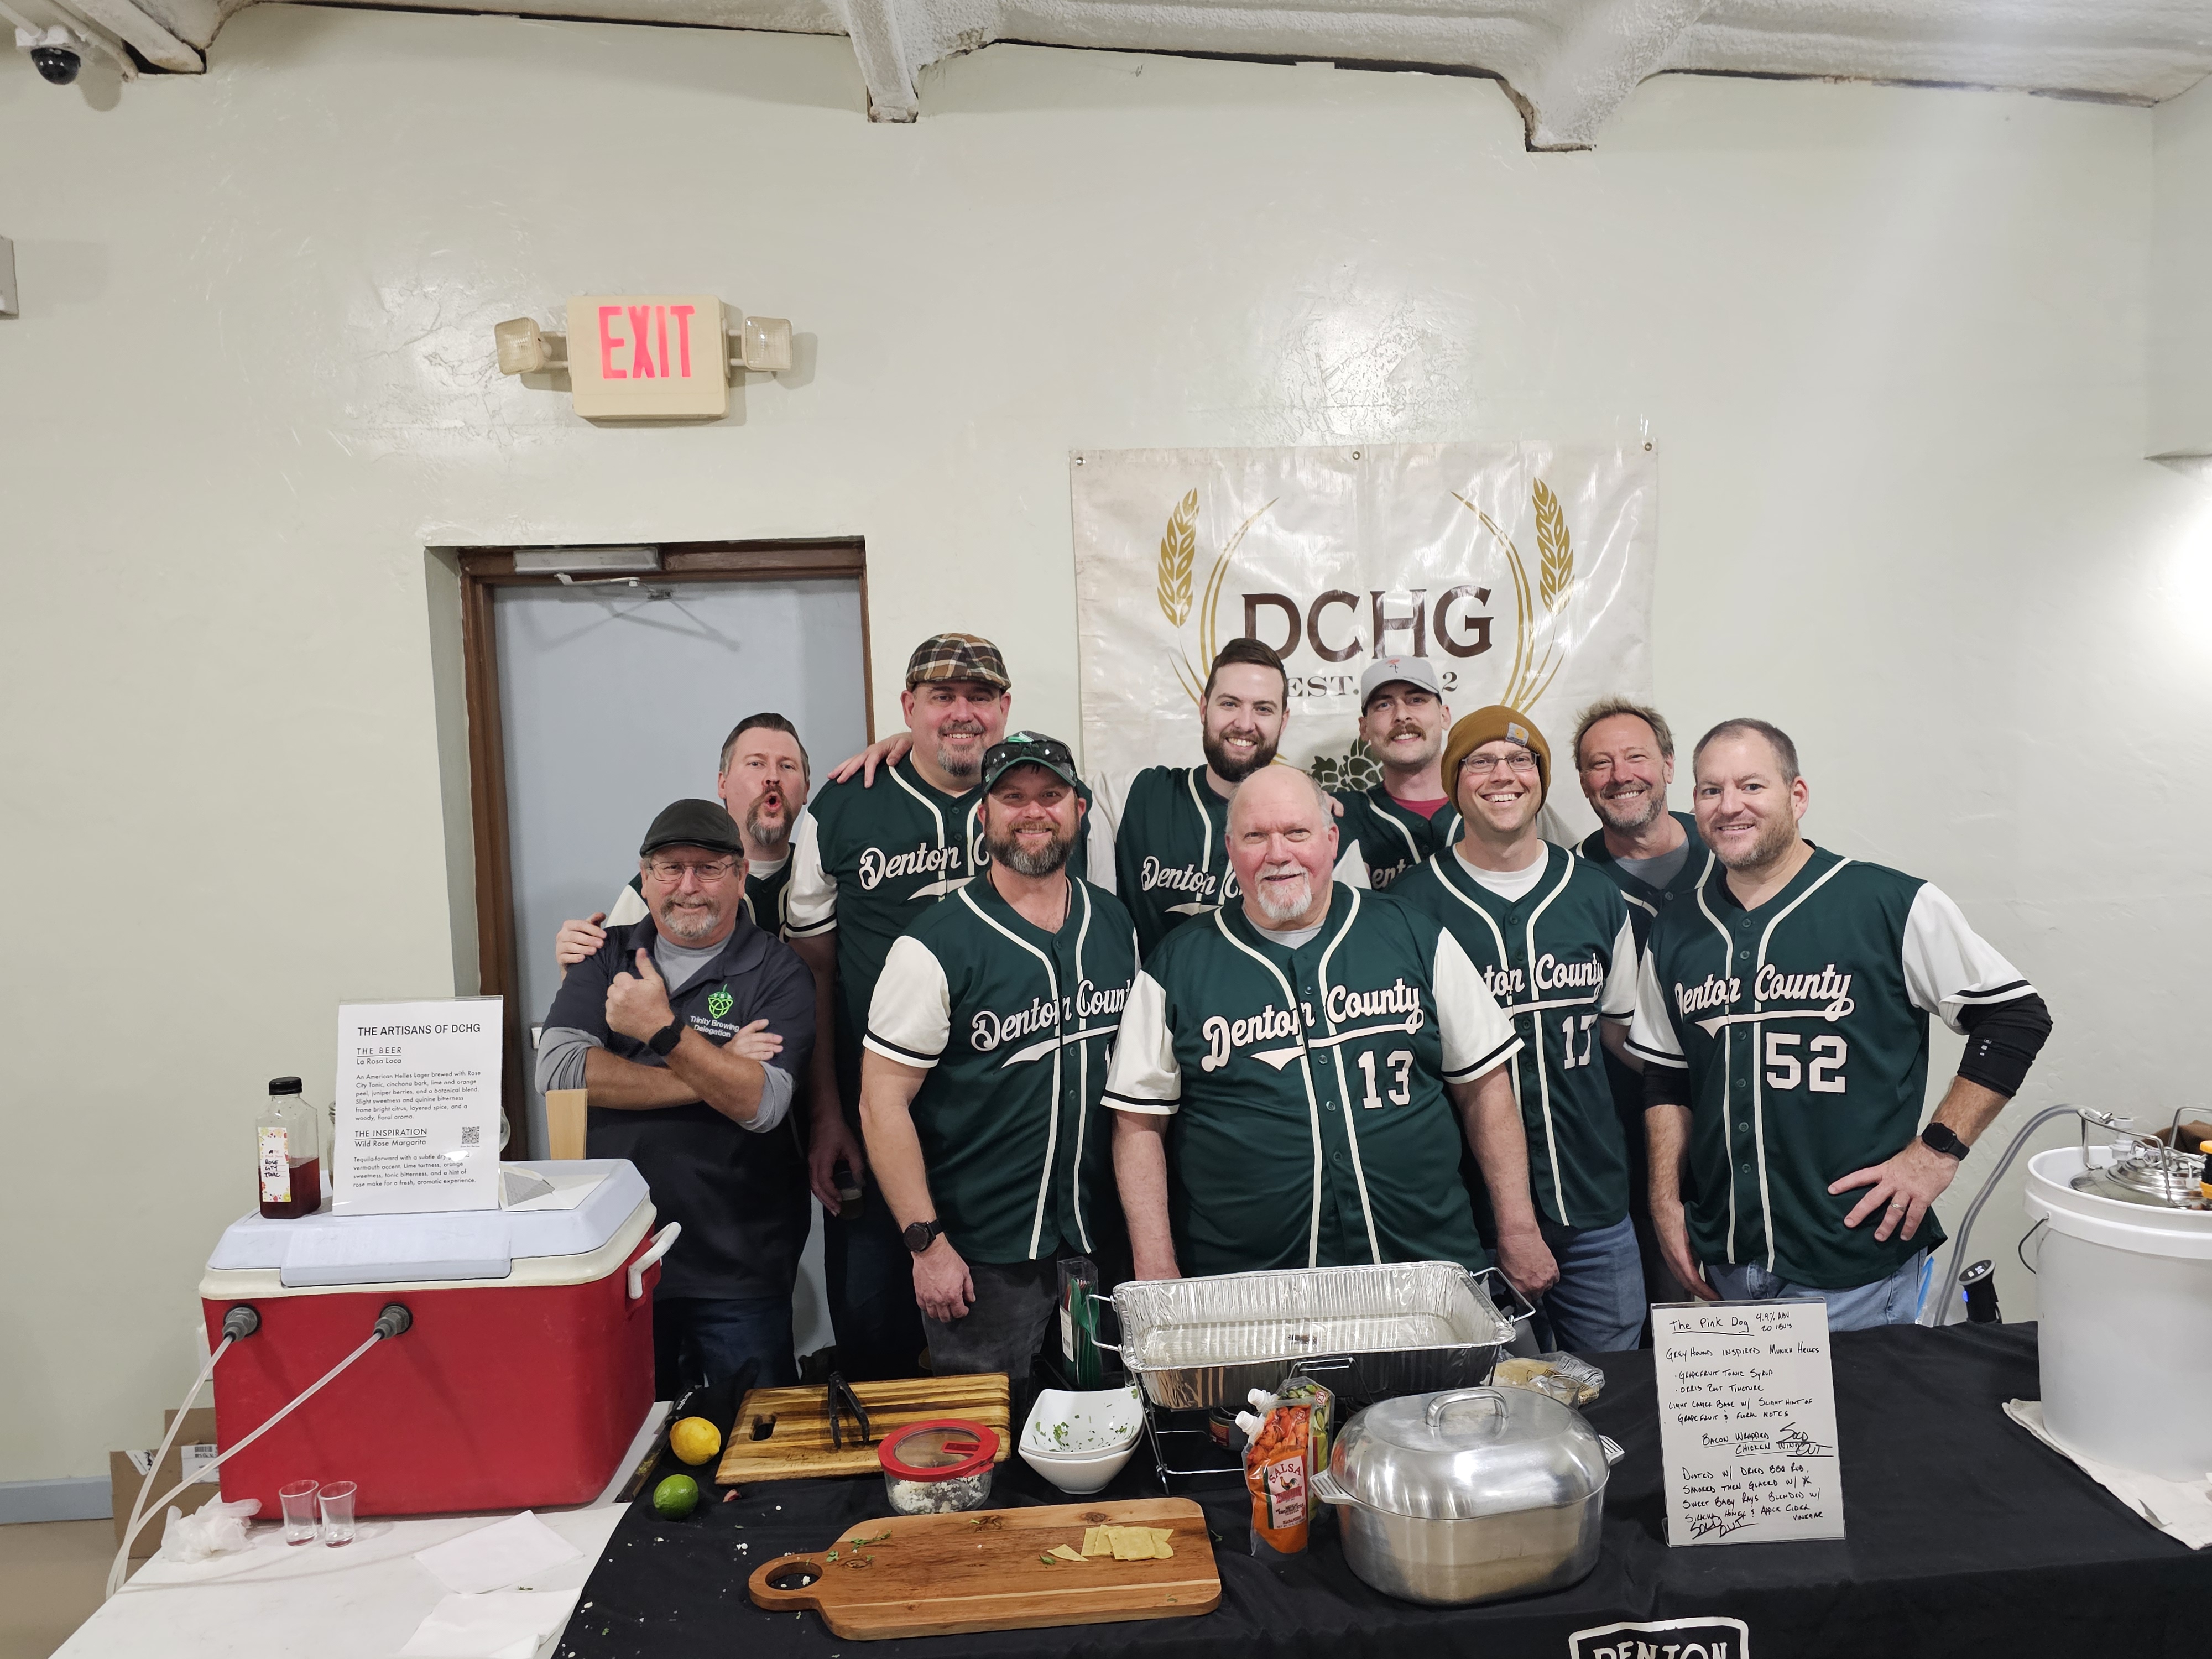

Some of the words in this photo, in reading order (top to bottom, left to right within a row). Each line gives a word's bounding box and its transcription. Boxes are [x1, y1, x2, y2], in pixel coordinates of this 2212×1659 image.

[598, 305, 695, 379] EXIT
[1242, 585, 1494, 662] DCHG
[1287, 676, 1359, 697] EST.
[859, 842, 961, 890] Denton
[1141, 855, 1215, 891] Denton
[1536, 953, 1604, 1000] County
[1754, 963, 1855, 1021] County
[971, 997, 1072, 1051] Denton
[1076, 979, 1130, 1017] Count
[358, 1027, 378, 1036] THE
[380, 1025, 431, 1035] ARTISANS
[435, 1025, 448, 1034] OF
[452, 1024, 481, 1033] DCHG
[690, 1015, 710, 1026] Trinity
[711, 1020, 739, 1032] Brewing
[694, 1025, 731, 1037] Delegation
[1201, 1001, 1315, 1072] Denton
[1327, 978, 1423, 1034] County
[1766, 1032, 1848, 1093] 52
[1358, 1050, 1414, 1109] 13
[392, 1139, 426, 1147] Margarita
[1756, 1311, 1775, 1322] 4.9%
[1778, 1311, 1790, 1320] ABV
[1669, 1319, 1691, 1330] The
[1700, 1317, 1723, 1328] Pink
[1732, 1317, 1749, 1333] Dog
[1722, 1347, 1760, 1356] INSPIRED
[1770, 1344, 1793, 1354] MUNICH
[1722, 1369, 1744, 1377] TONIC
[1750, 1368, 1773, 1380] SYRUP
[1729, 1384, 1764, 1392] TINCTURE
[1717, 1400, 1734, 1408] BASE
[1759, 1397, 1783, 1406] SLIGHT
[1737, 1411, 1757, 1420] FLORAL
[1702, 1433, 1729, 1446] BACON
[1735, 1431, 1770, 1441] WRAPPED
[1777, 1422, 1808, 1443] SOLD
[1735, 1442, 1770, 1454] CHICKEN
[1796, 1442, 1833, 1455] OUT
[1269, 1464, 1301, 1484] SALSA
[1682, 1467, 1714, 1480] DUSTED
[1740, 1466, 1764, 1475] DRIED
[1770, 1465, 1785, 1474] BBQ
[1683, 1485, 1715, 1494] SMOKED
[1721, 1483, 1741, 1491] THEN
[1749, 1481, 1778, 1491] GLAZED
[1682, 1499, 1709, 1509] SWEET
[1715, 1496, 1735, 1511] BABY
[1742, 1492, 1759, 1505] RAYS
[1768, 1491, 1804, 1502] BLENDED
[1724, 1510, 1746, 1519] HONEY
[1761, 1505, 1781, 1515] APPLE
[1793, 1512, 1823, 1521] VINEGAR
[1690, 1516, 1722, 1540] SOLD
[1719, 1517, 1759, 1538] OUT
